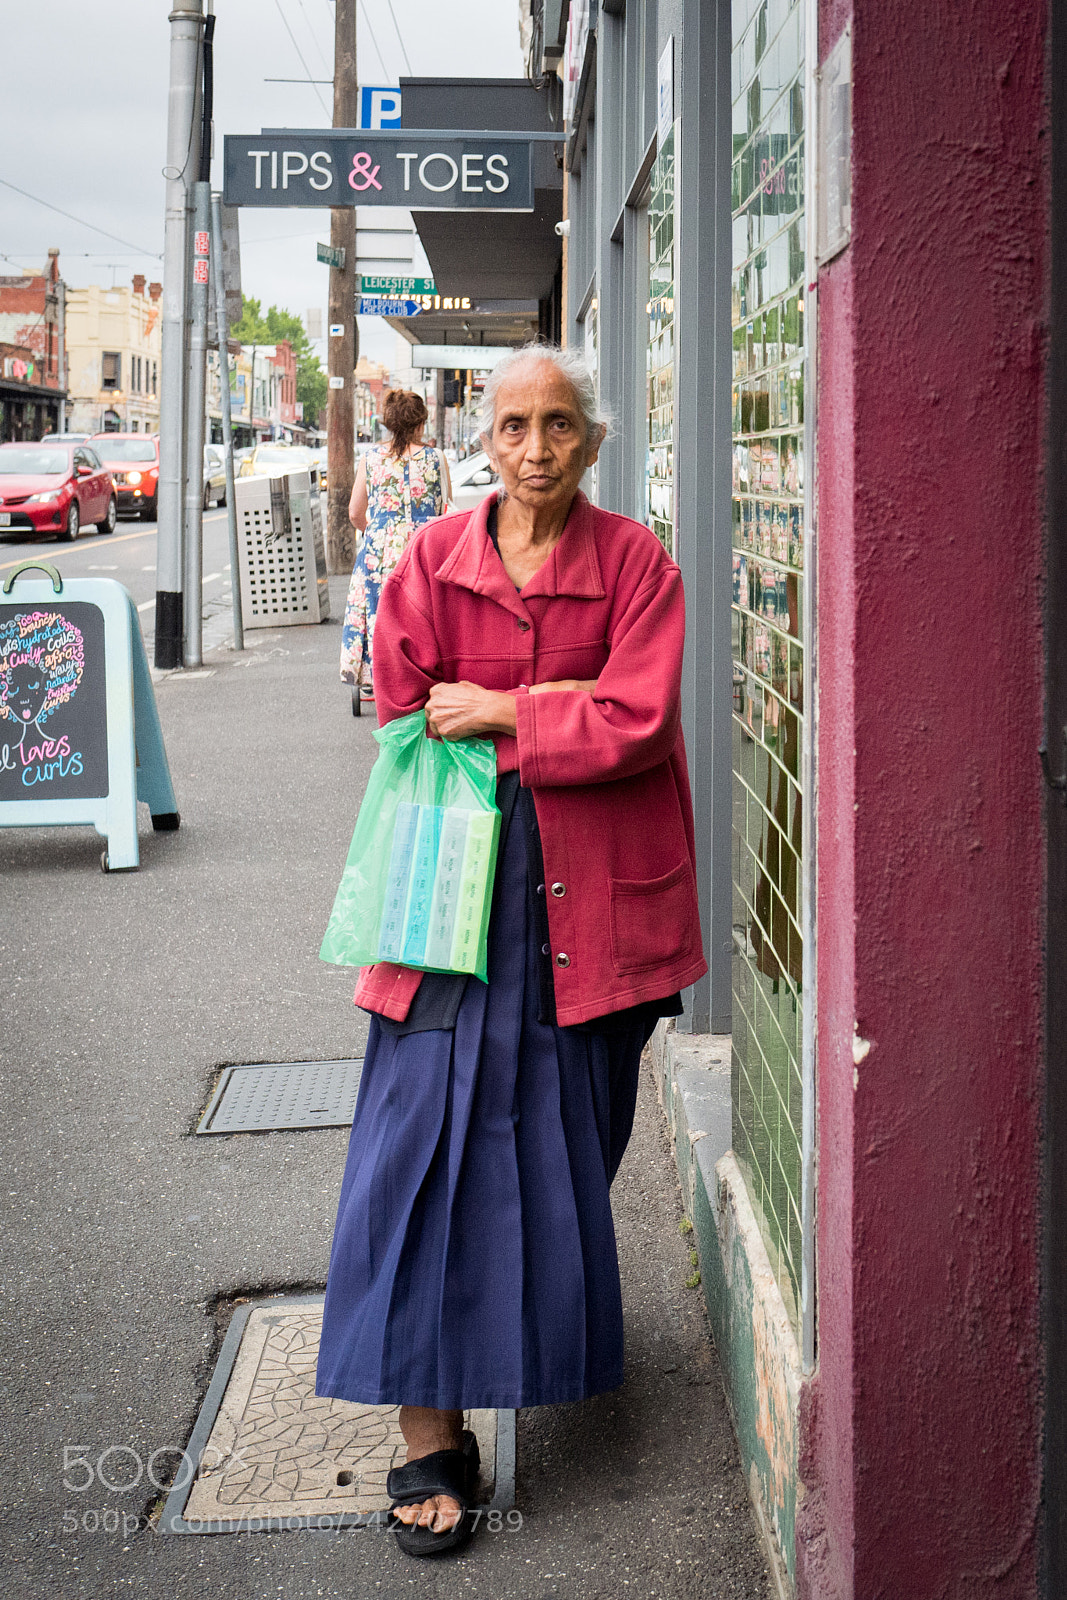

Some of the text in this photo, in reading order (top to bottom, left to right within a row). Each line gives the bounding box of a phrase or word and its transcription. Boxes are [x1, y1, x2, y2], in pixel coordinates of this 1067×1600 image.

[247, 150, 510, 194] TIPS & TOES
[365, 277, 435, 290] LEICESTER ST
[16, 619, 66, 653] hydrated
[17, 612, 61, 638] bouncy
[45, 647, 72, 670] afro
[21, 752, 84, 787] curls
